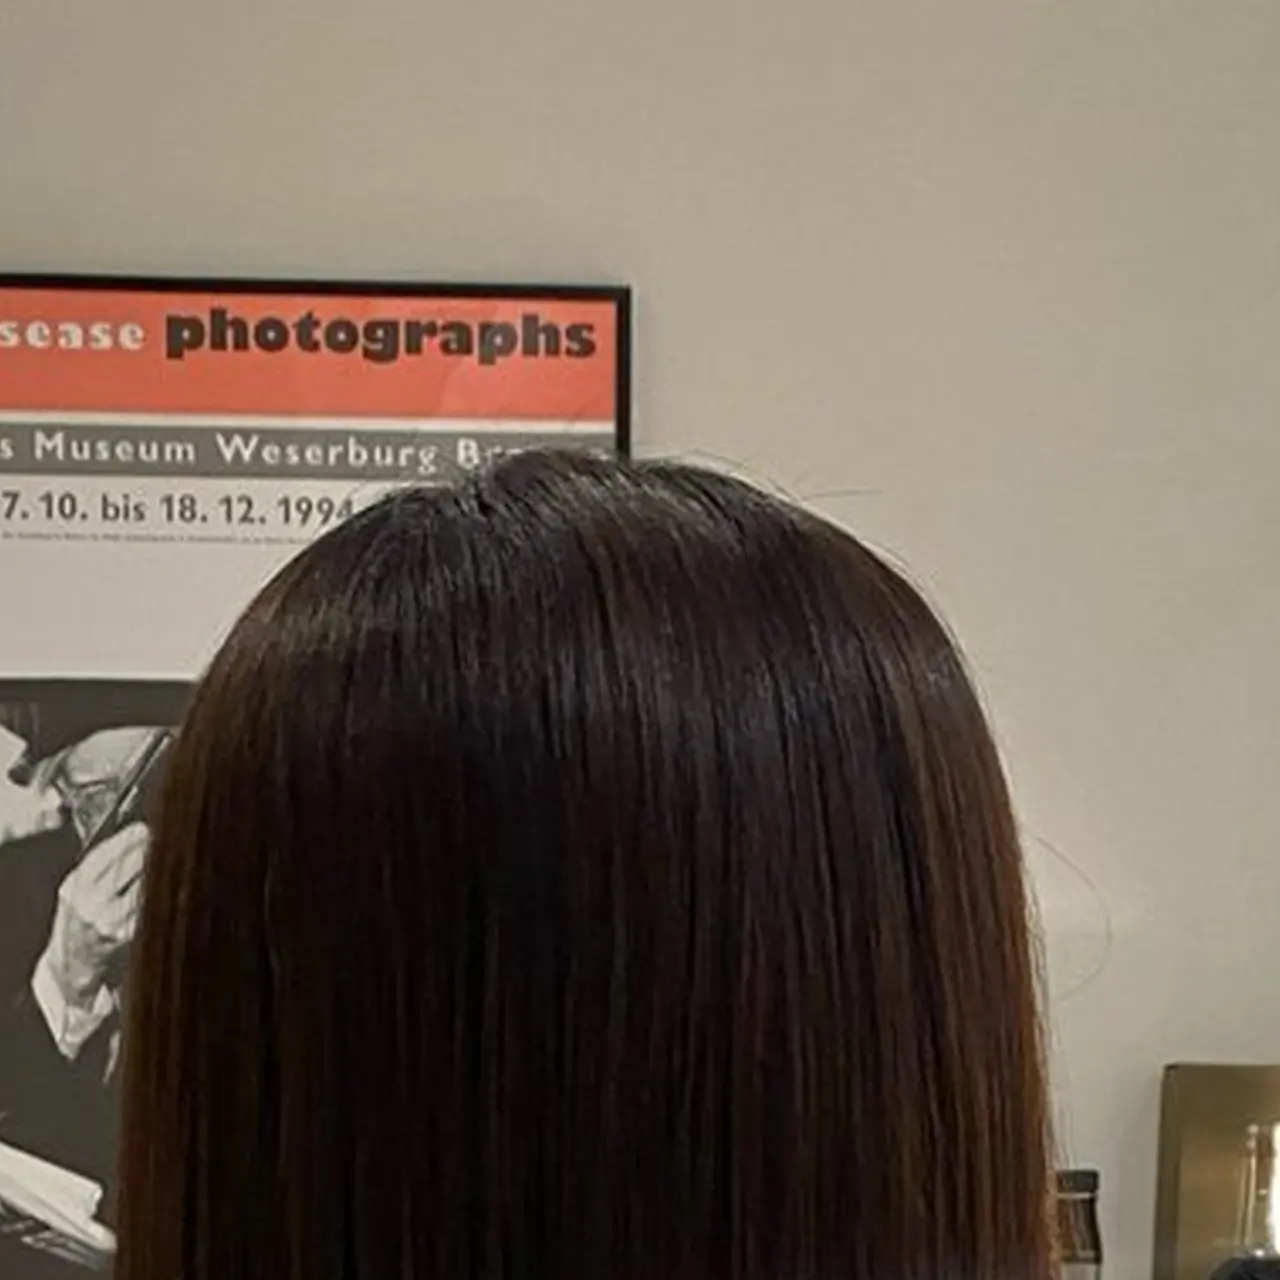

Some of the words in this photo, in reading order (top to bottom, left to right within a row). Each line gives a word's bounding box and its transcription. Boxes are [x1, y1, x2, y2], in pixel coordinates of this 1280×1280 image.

[165, 307, 597, 365] photographs
[33, 430, 196, 465] Museum
[216, 433, 440, 476] Weserburg
[1, 491, 30, 521] 7.
[38, 492, 88, 521] 10.
[101, 493, 146, 523] bis
[160, 494, 208, 524] 18.
[219, 495, 267, 525] 12.
